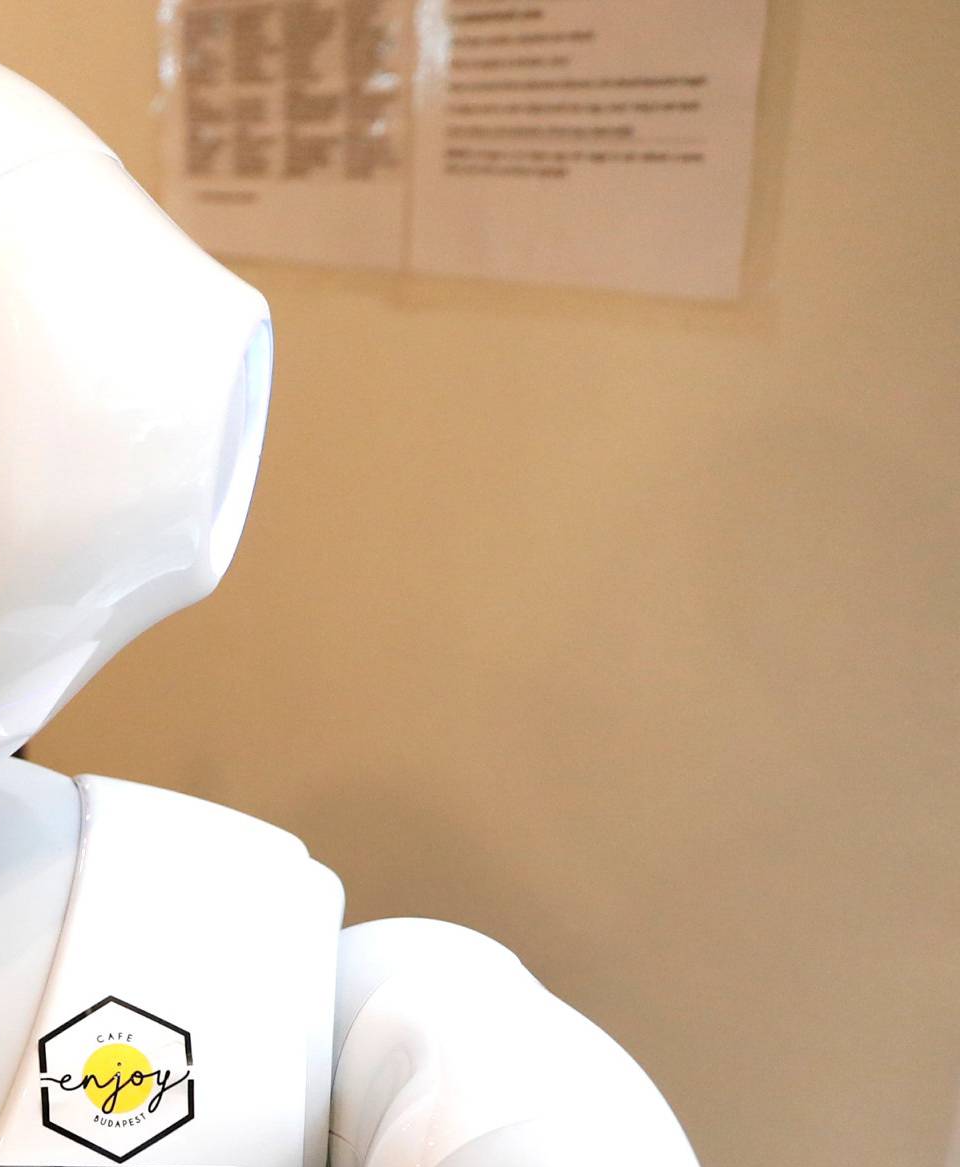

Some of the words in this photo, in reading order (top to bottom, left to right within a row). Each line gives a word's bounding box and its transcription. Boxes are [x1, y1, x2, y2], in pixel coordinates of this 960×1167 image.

[96, 1032, 133, 1043] CAFE
[40, 1062, 190, 1114] enjoy
[93, 1113, 146, 1128] BUDAPEST
